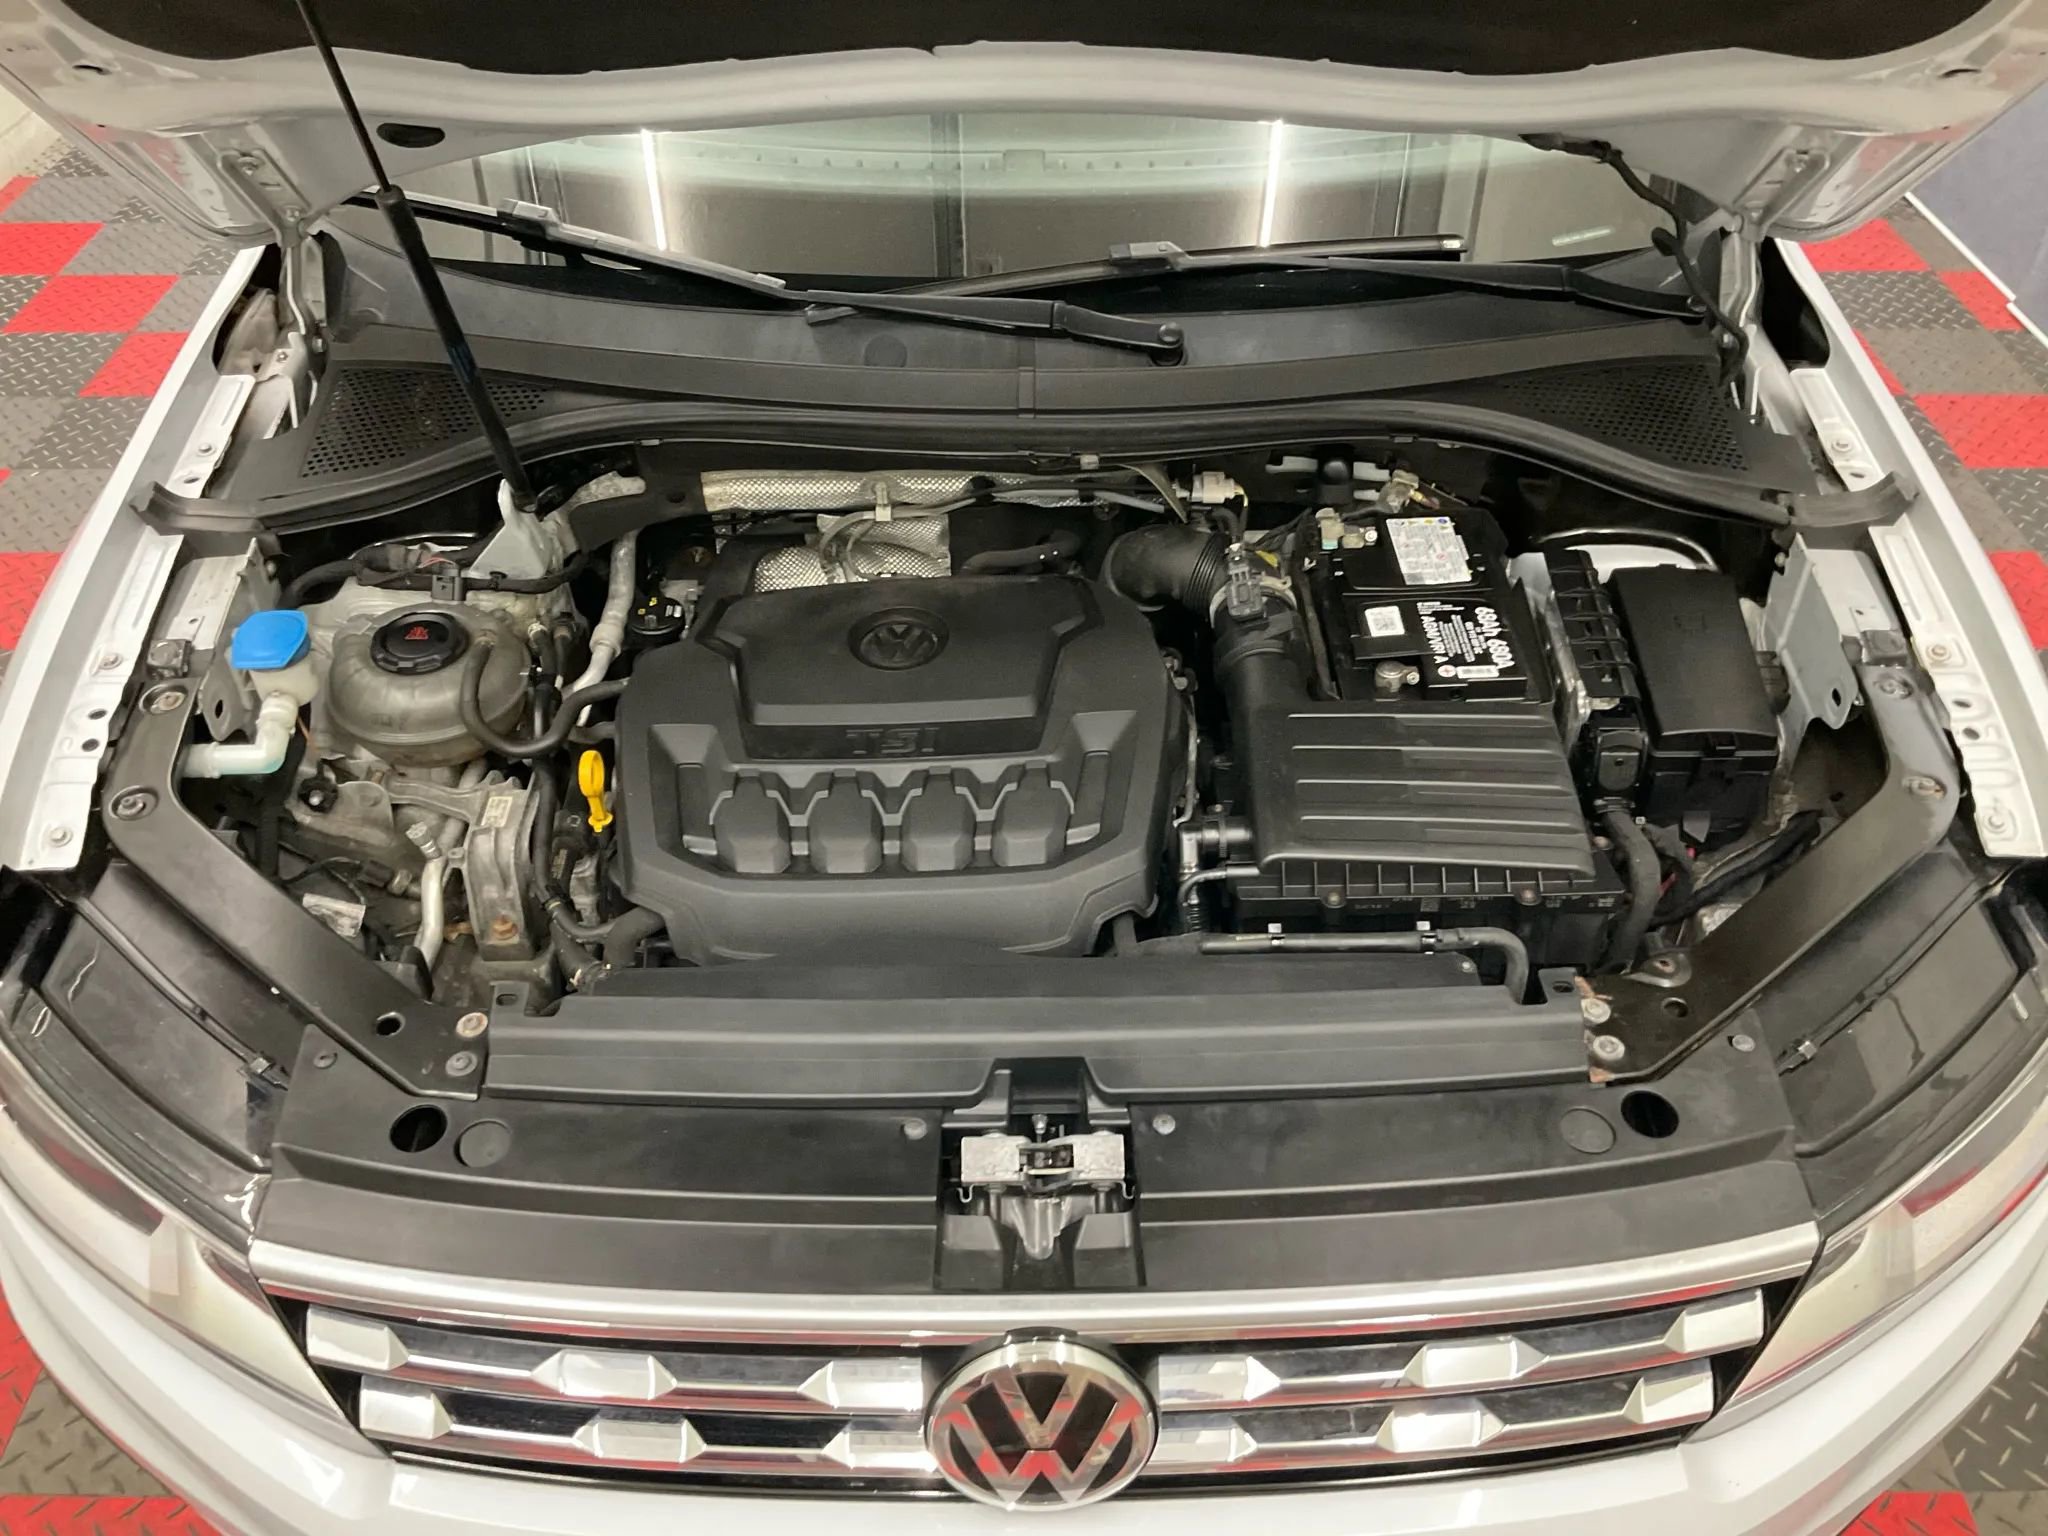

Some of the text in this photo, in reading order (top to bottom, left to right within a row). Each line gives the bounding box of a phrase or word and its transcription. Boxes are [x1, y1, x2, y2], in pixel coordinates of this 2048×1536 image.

[1474, 606, 1502, 637] 68Ah
[1486, 638, 1515, 670] 680A
[845, 727, 940, 755] TSI
[936, 1356, 1147, 1508] VW
